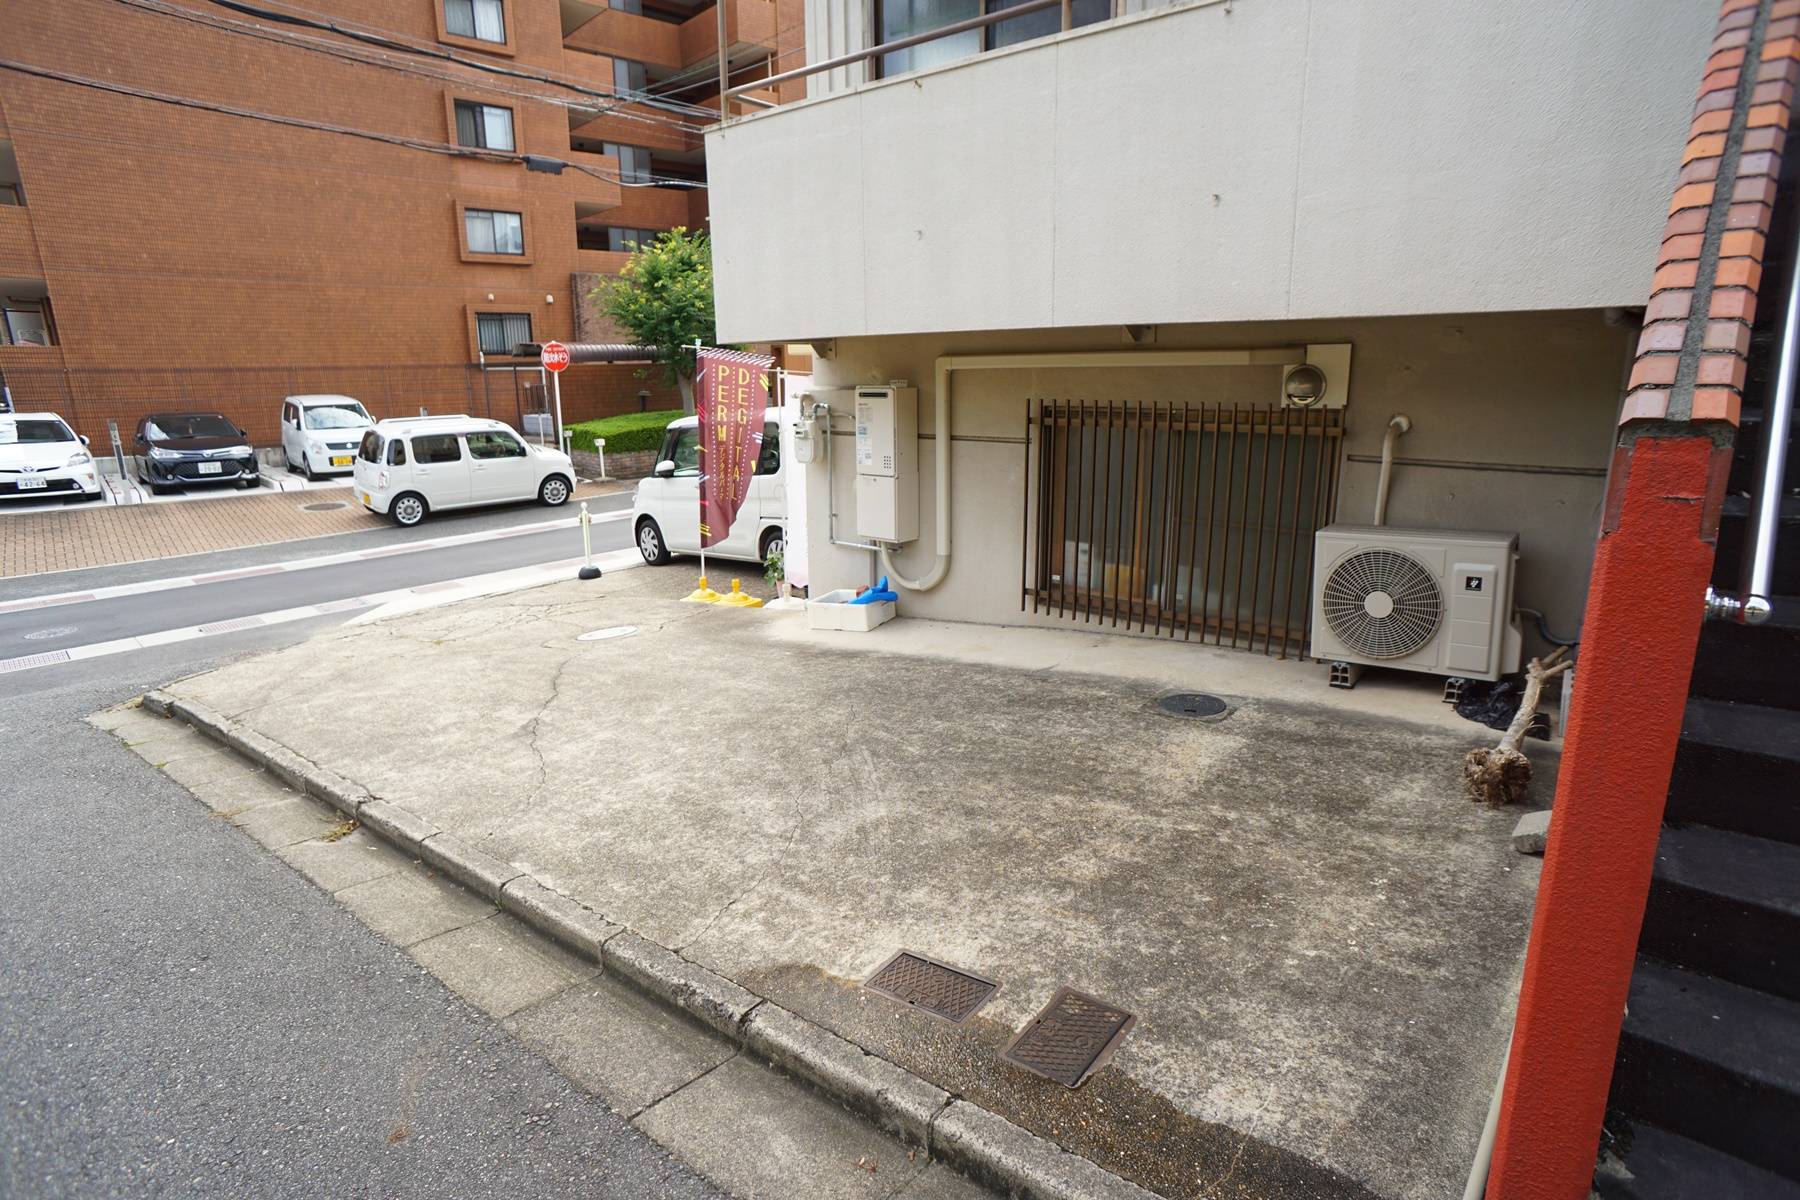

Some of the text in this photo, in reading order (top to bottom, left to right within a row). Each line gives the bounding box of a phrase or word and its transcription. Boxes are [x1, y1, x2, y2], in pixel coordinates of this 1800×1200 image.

[717, 364, 730, 442] PERM
[731, 367, 750, 501] DEGITAL
[718, 444, 727, 500] デジタルパーマ
